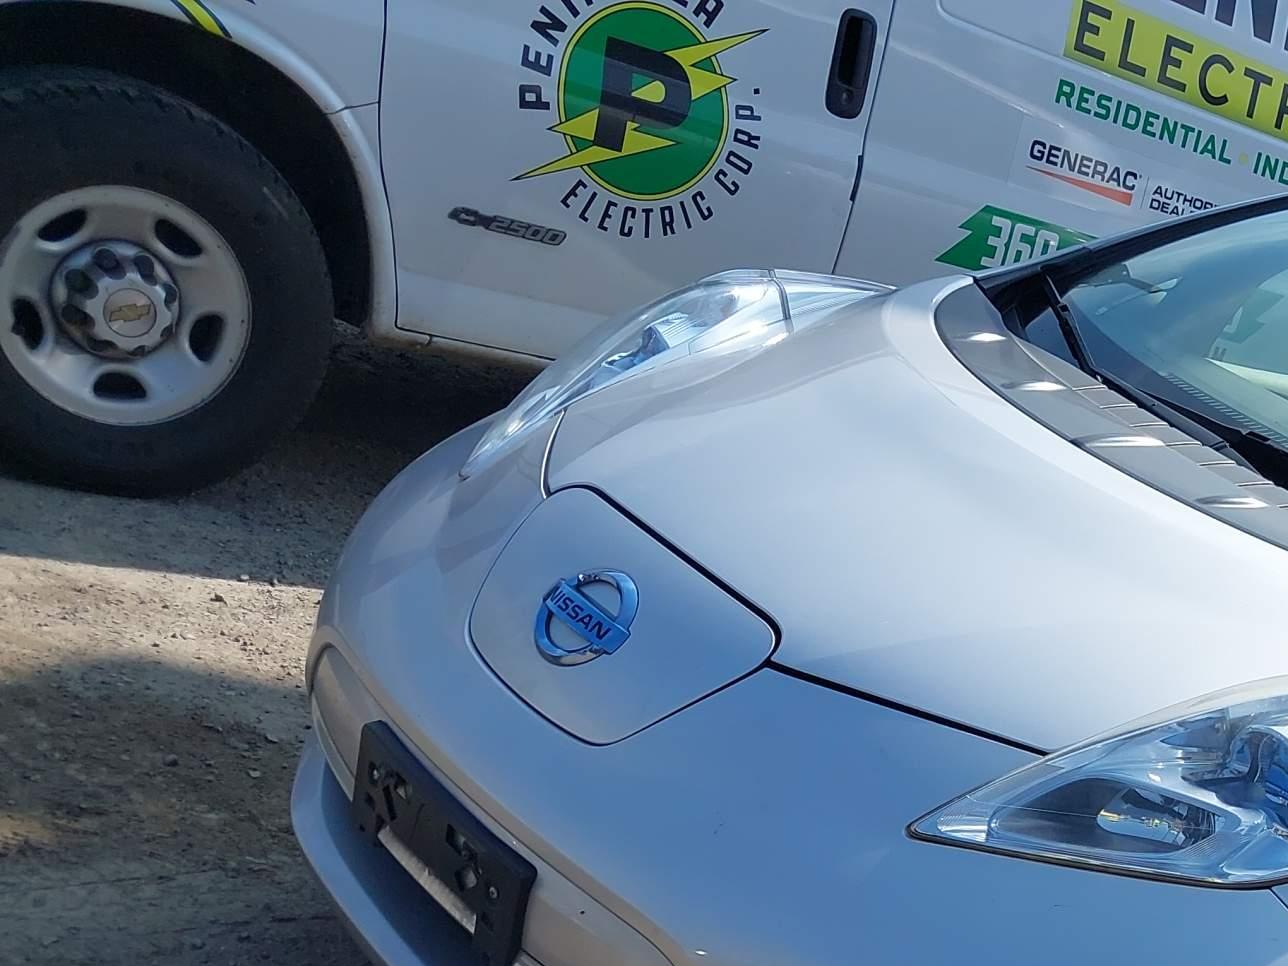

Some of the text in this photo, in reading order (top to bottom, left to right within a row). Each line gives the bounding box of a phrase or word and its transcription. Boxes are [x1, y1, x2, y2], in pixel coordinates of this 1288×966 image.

[1055, 79, 1232, 165] RESIDENTIAL
[560, 87, 762, 239] ELECTRIC CORP.
[1029, 140, 1139, 192] GENERAC
[549, 587, 612, 641] NISSAN
